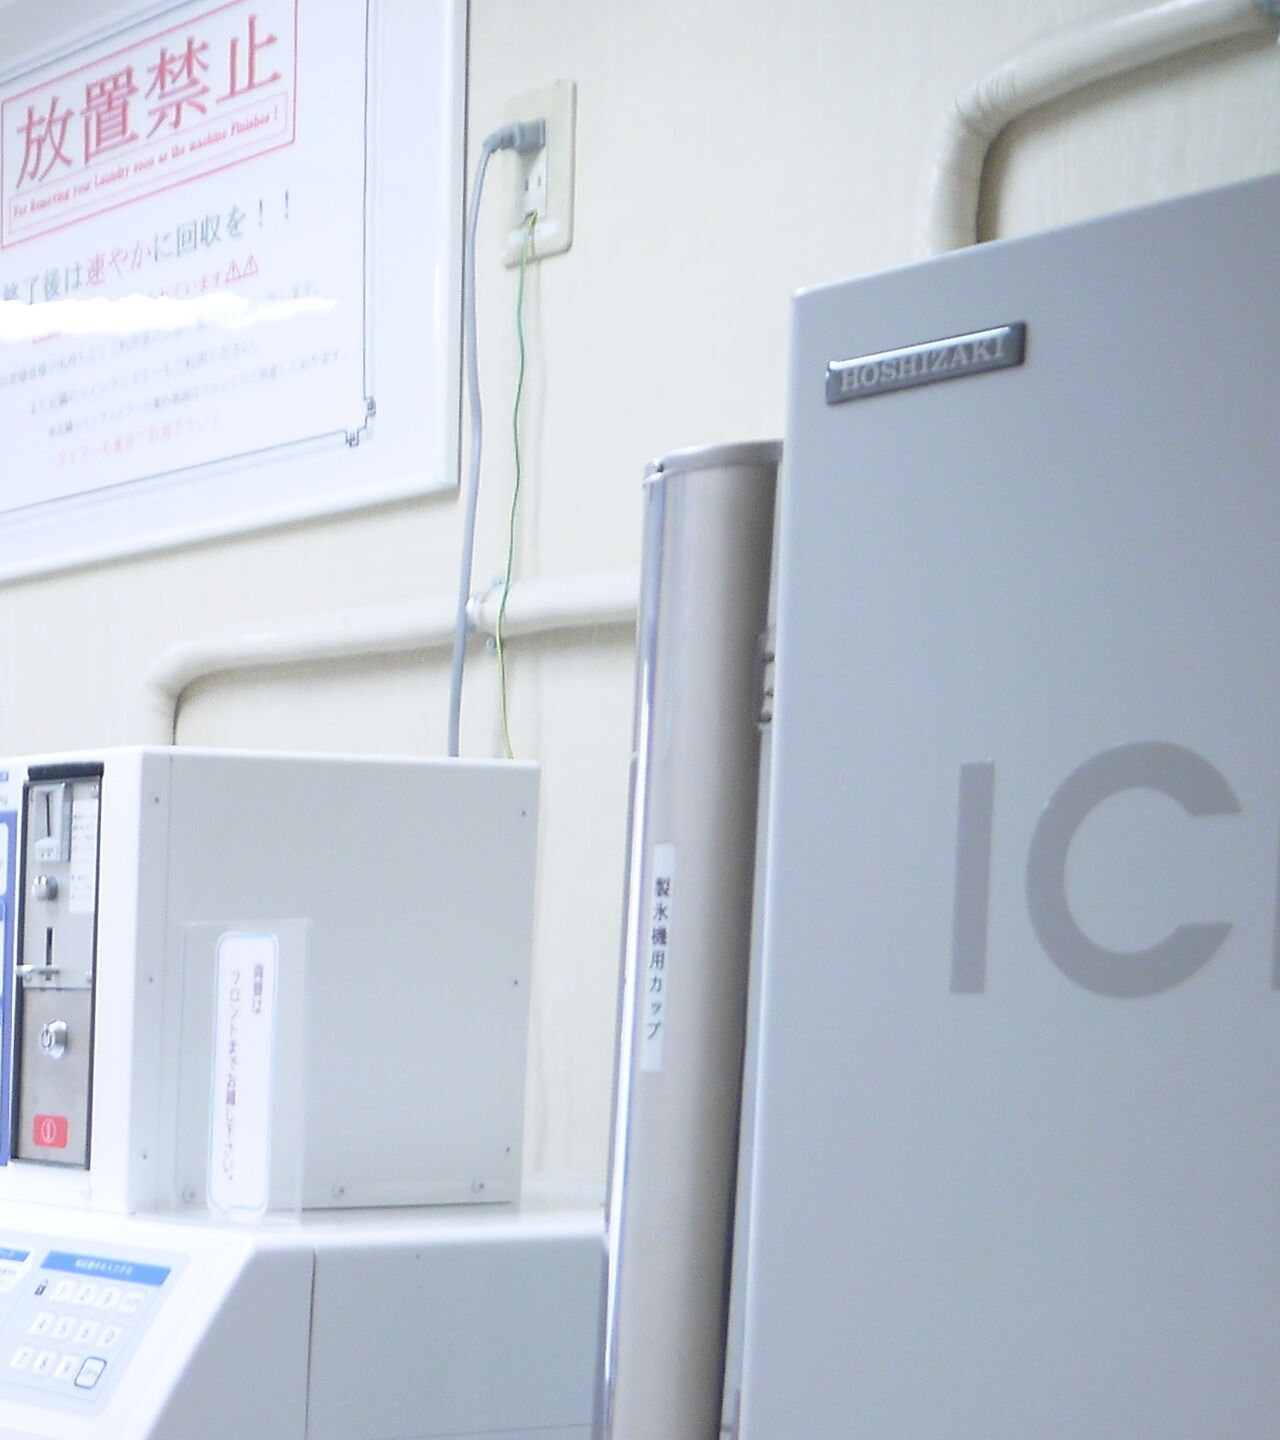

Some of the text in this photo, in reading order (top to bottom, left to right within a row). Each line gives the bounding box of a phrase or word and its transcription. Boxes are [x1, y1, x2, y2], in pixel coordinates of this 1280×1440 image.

[15, 13, 282, 190] 放置禁止
[840, 336, 1007, 391] HOSHIZAKI
[949, 740, 1280, 999] IC
